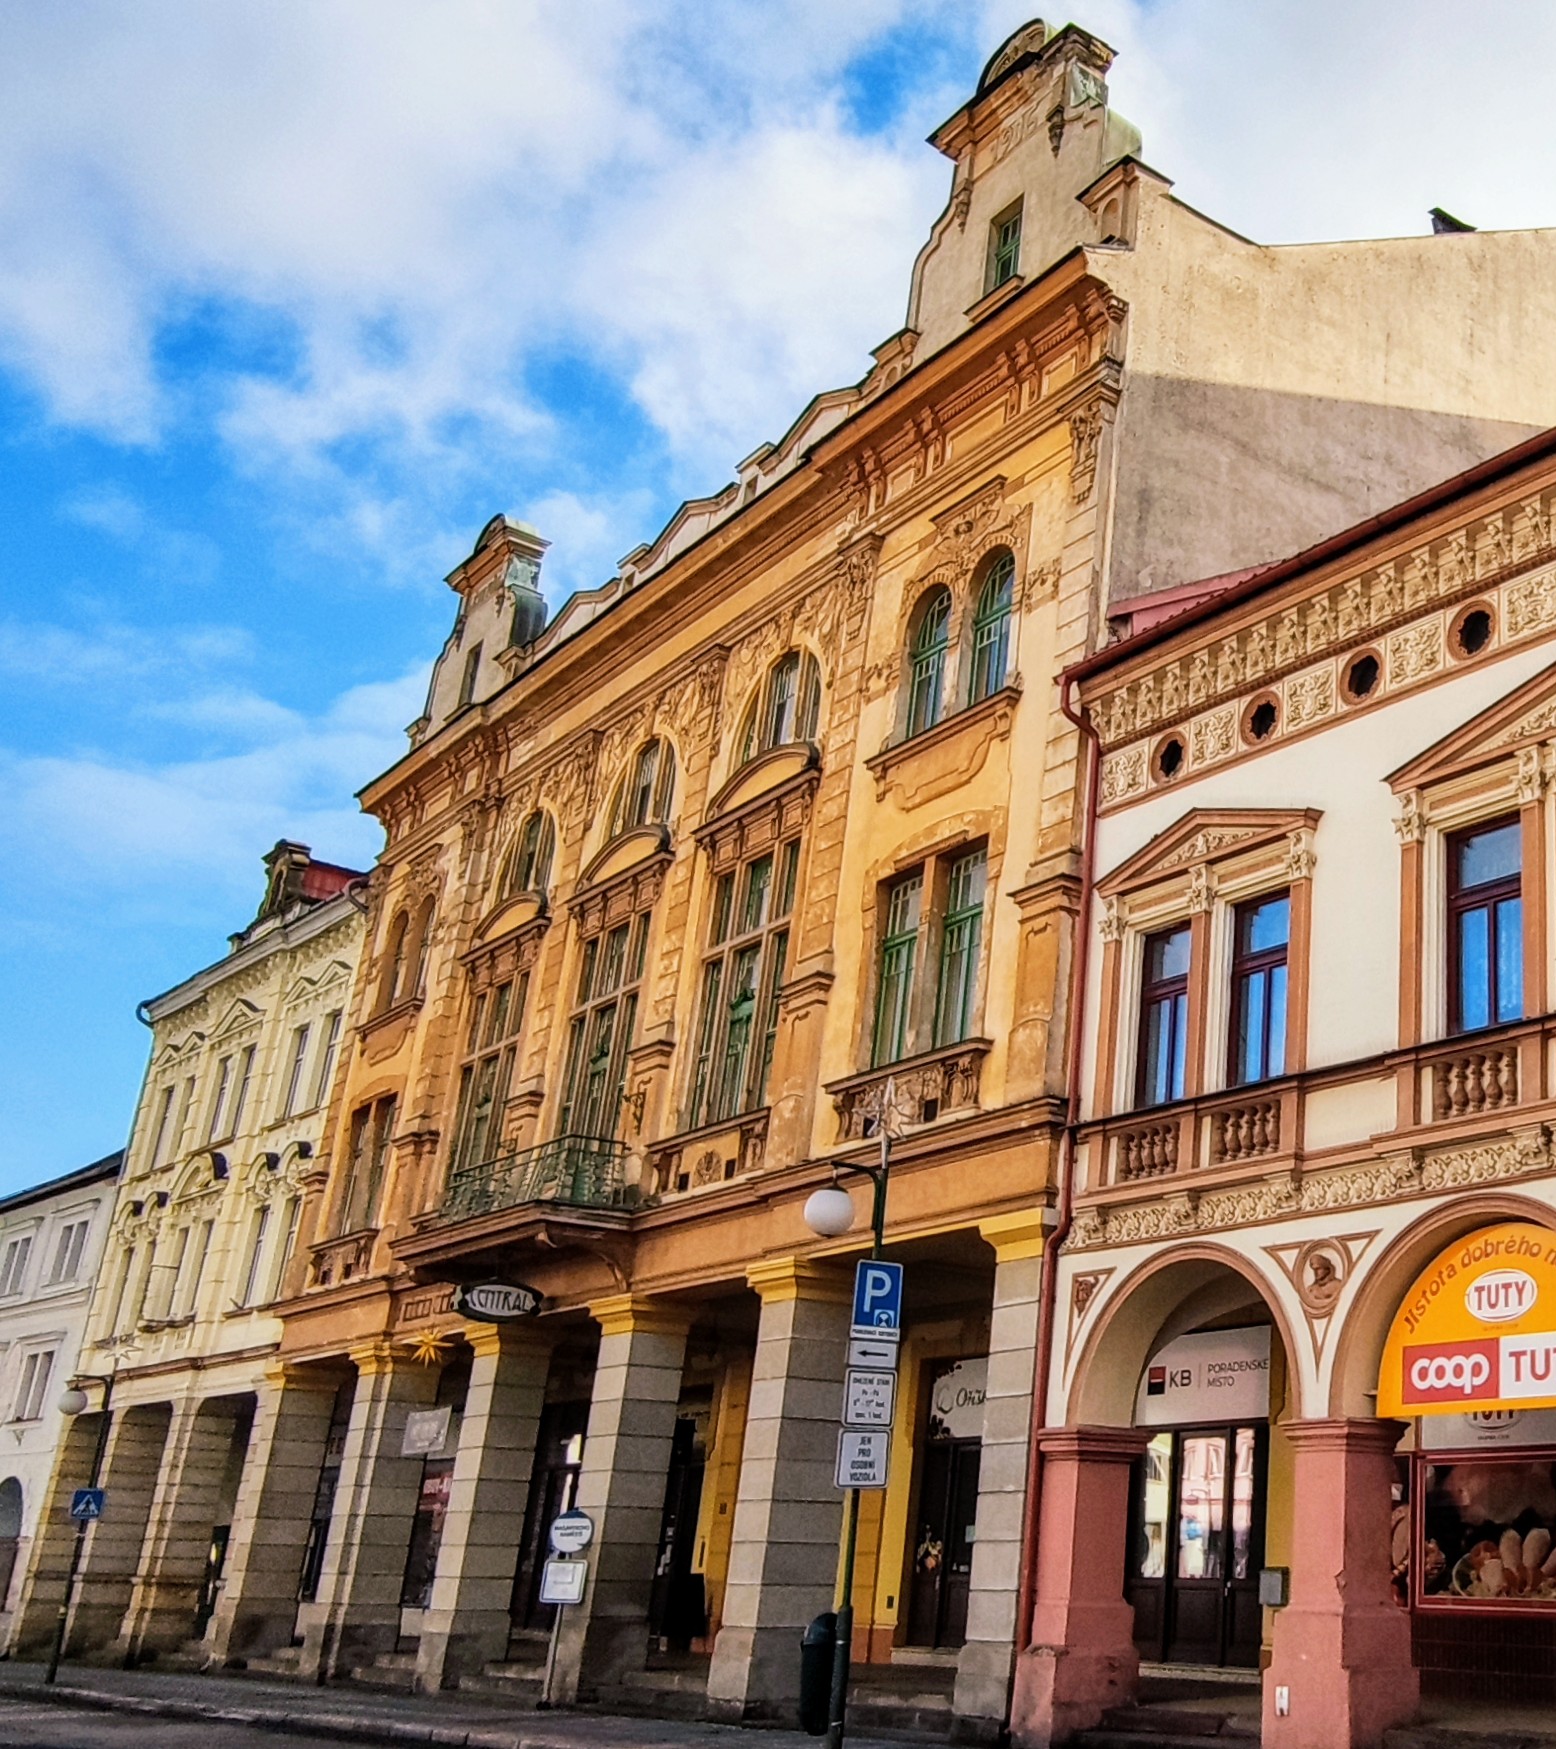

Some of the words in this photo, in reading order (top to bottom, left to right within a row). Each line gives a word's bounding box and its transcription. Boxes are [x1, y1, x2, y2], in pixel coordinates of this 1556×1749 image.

[1461, 1235, 1542, 1268] dobrého
[863, 1269, 892, 1313] P
[1474, 1280, 1527, 1311] TUTY
[1169, 1369, 1192, 1388] KB
[1411, 1353, 1490, 1394] coop
[857, 1447, 872, 1458] PRO
[859, 1436, 872, 1446] JEN
